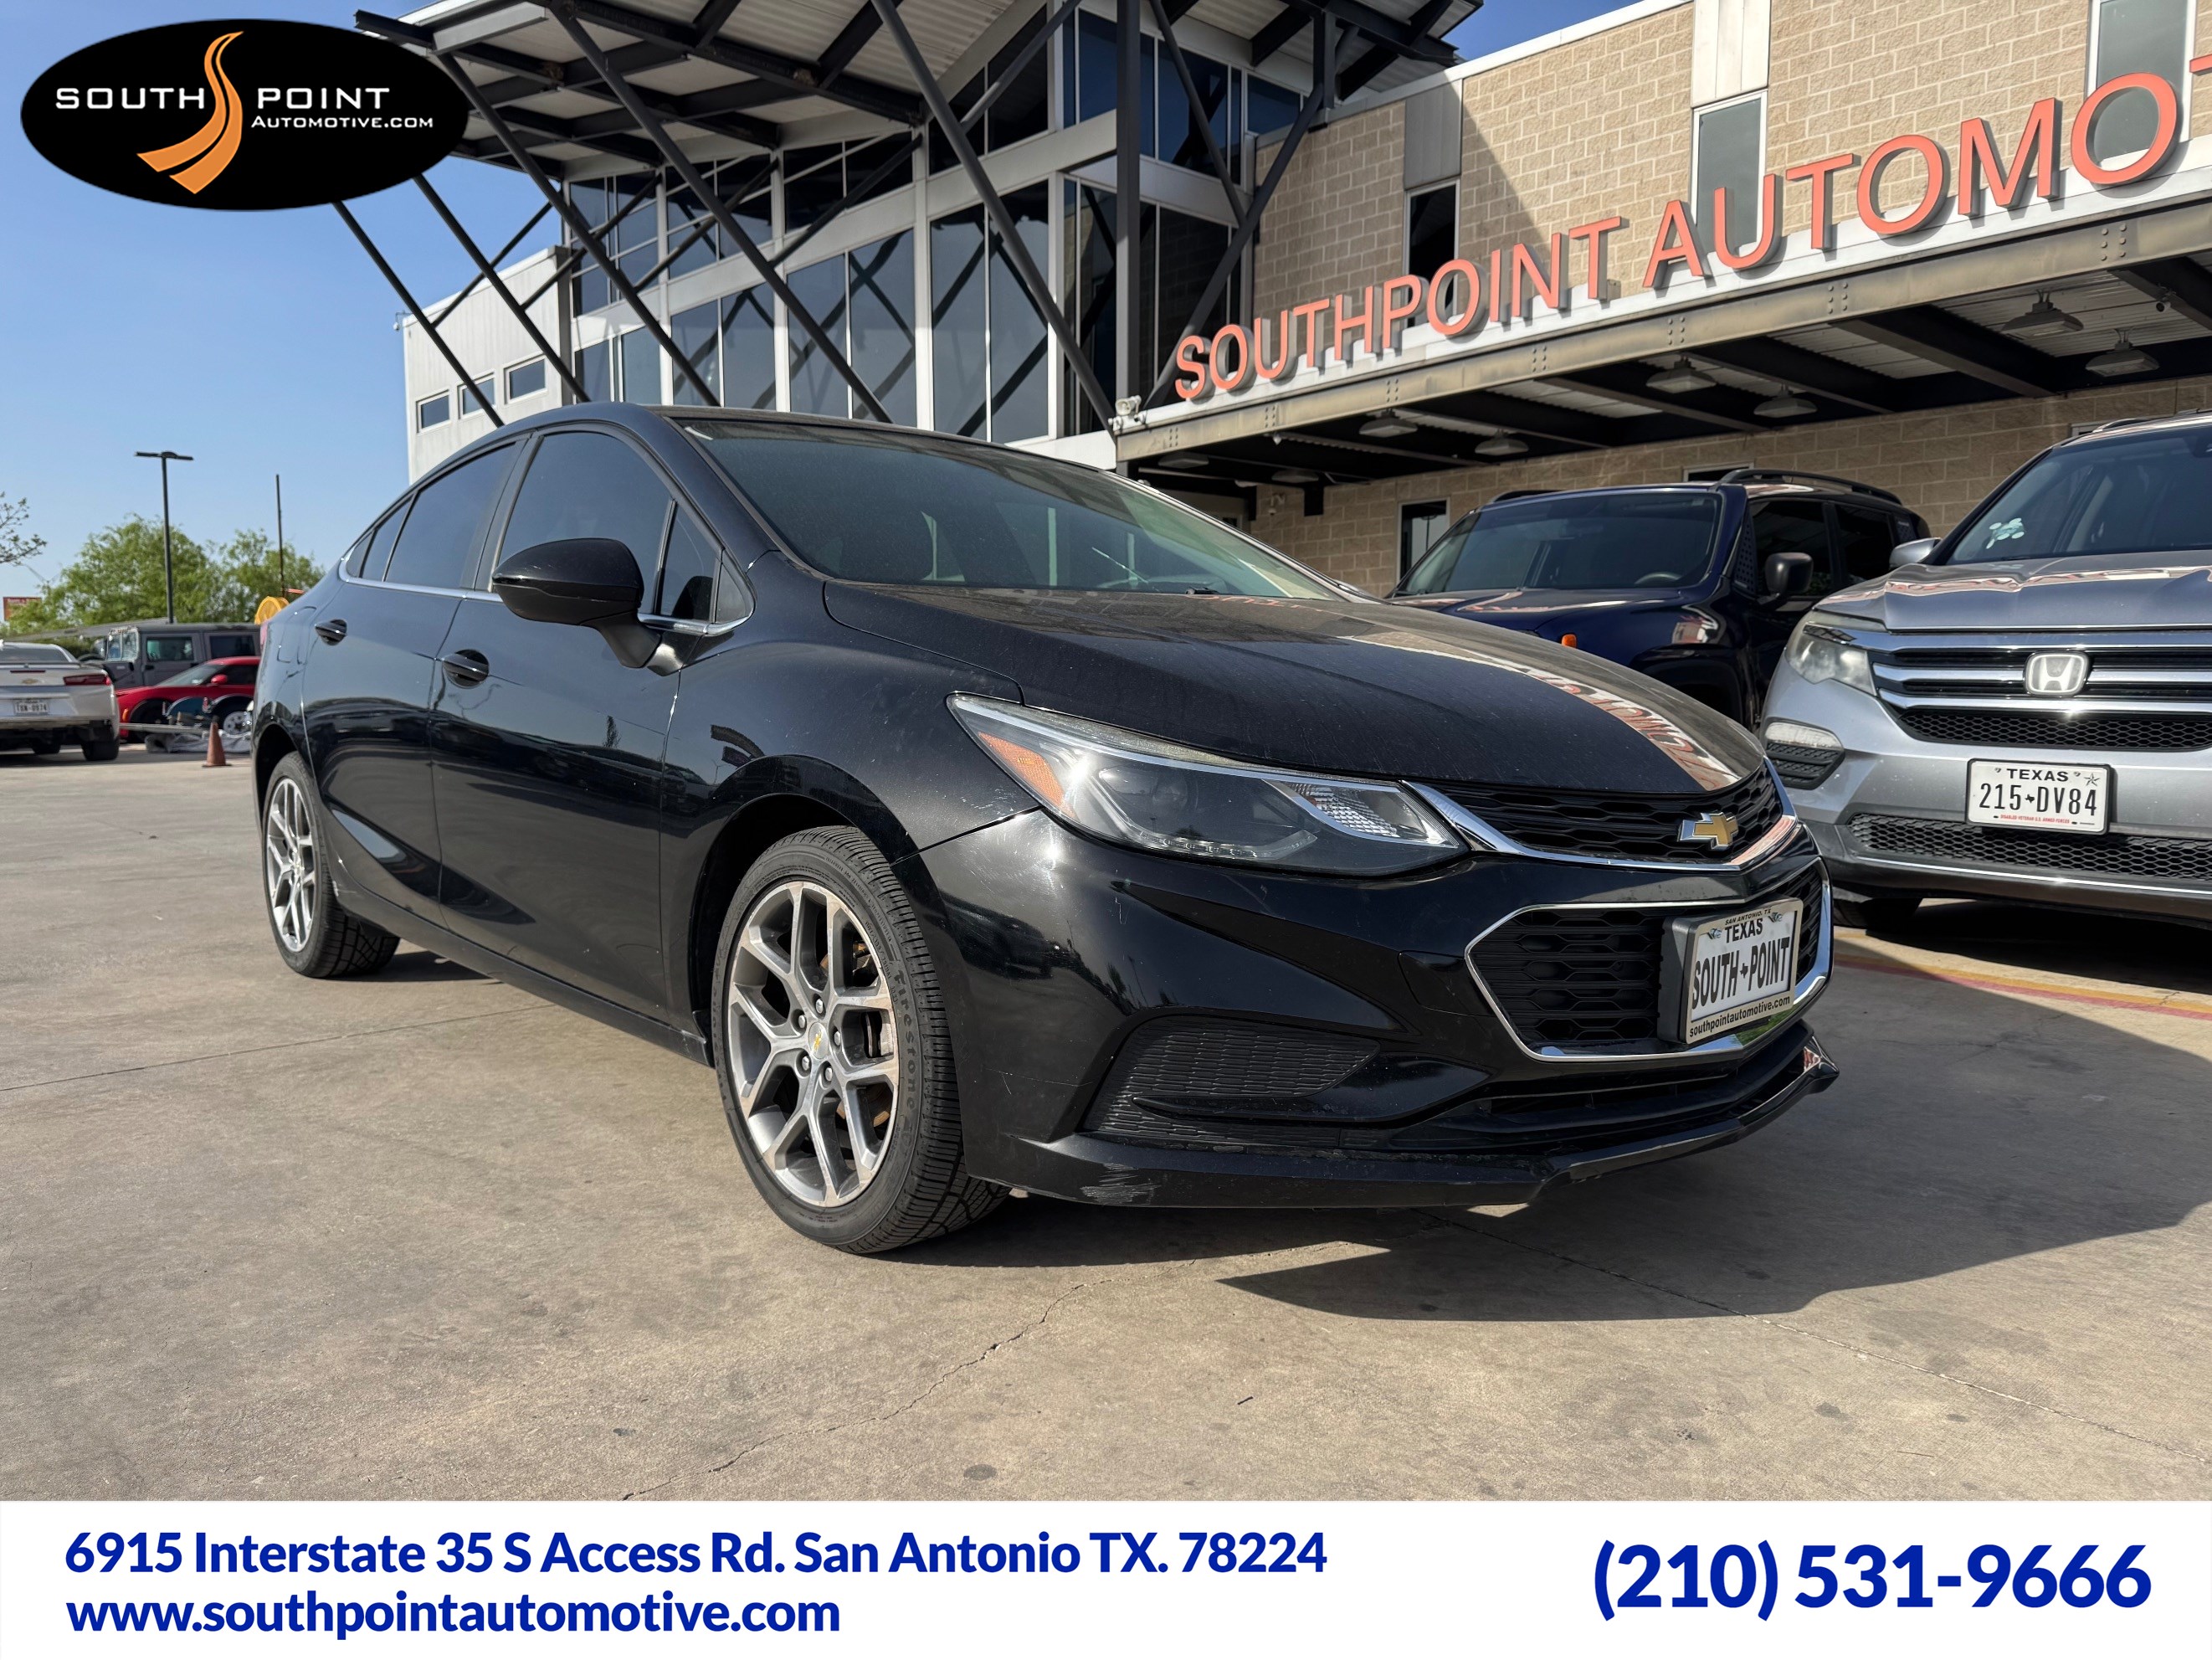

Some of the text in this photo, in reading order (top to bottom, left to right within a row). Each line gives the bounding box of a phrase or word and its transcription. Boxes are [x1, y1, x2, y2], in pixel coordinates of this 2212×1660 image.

[1173, 54, 2212, 400] SOUTHPOINT AUTOMO
[2006, 768, 2069, 782] TEXAS
[1724, 917, 1763, 943] TEXAS
[1725, 917, 1737, 926] SAN
[1689, 994, 1791, 1038] southpointautomotive.com
[894, 969, 916, 1111] Firestone
